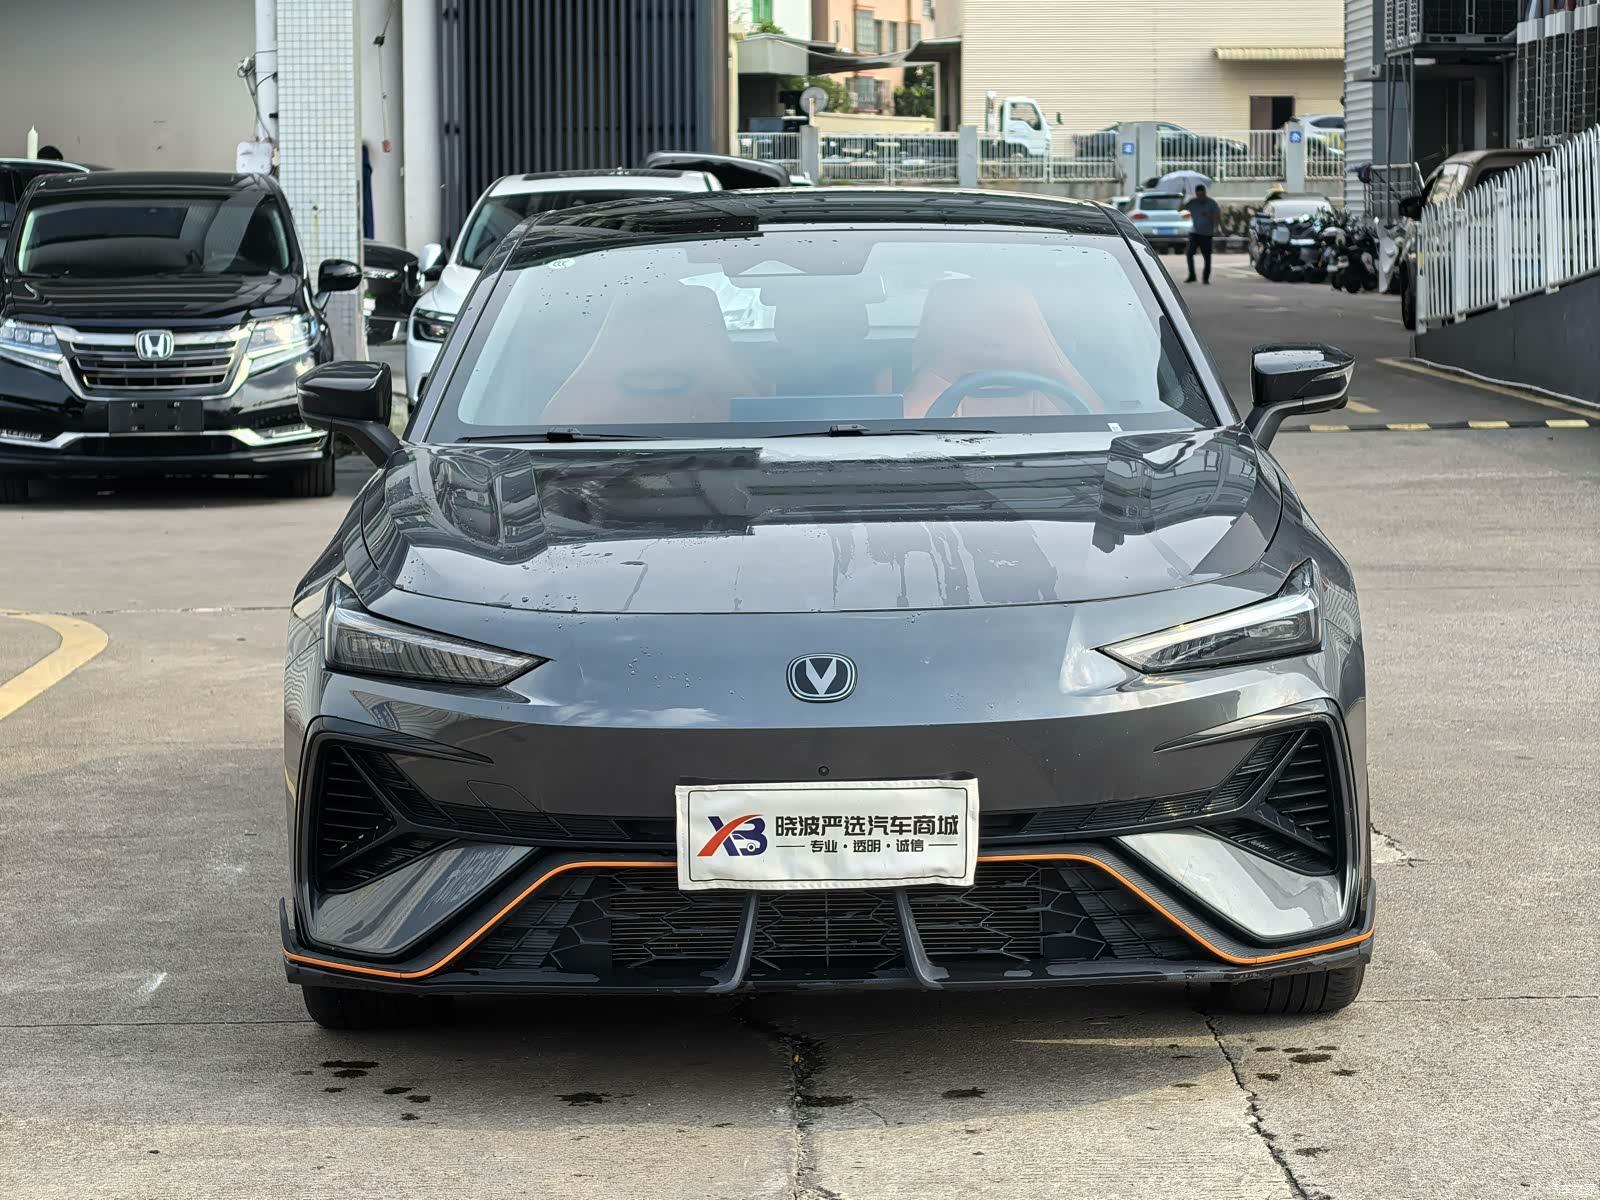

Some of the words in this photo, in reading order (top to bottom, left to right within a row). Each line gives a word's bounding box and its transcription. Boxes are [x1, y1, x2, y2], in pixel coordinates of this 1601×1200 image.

[775, 815, 959, 836] 晓波严选汽车商城
